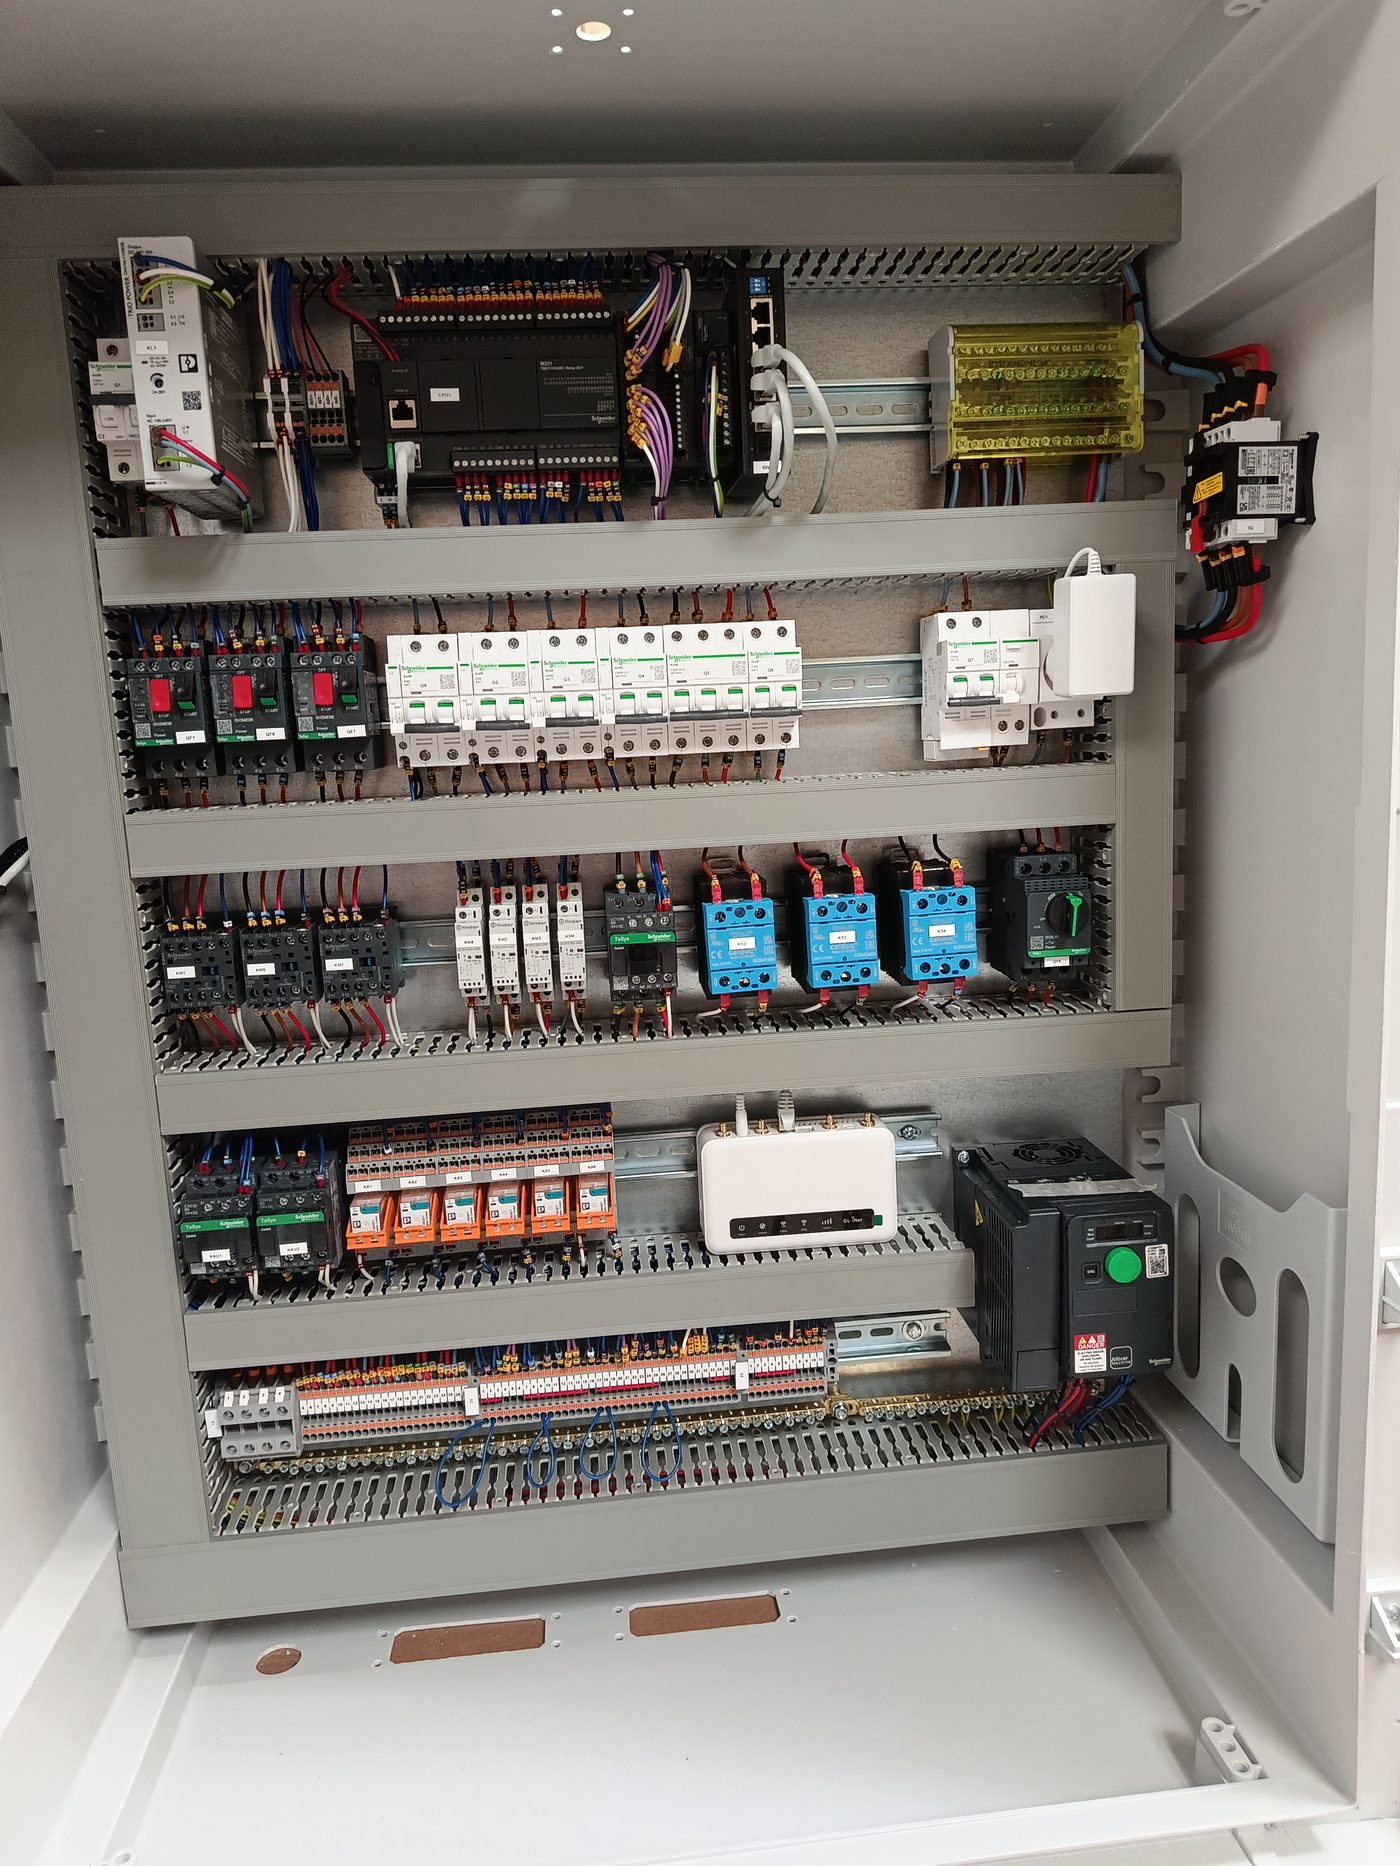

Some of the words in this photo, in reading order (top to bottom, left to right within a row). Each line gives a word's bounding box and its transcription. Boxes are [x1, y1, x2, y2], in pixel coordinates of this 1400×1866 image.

[90, 364, 116, 372] Schneider
[473, 663, 497, 671] Schneider
[543, 660, 568, 668] Schneider
